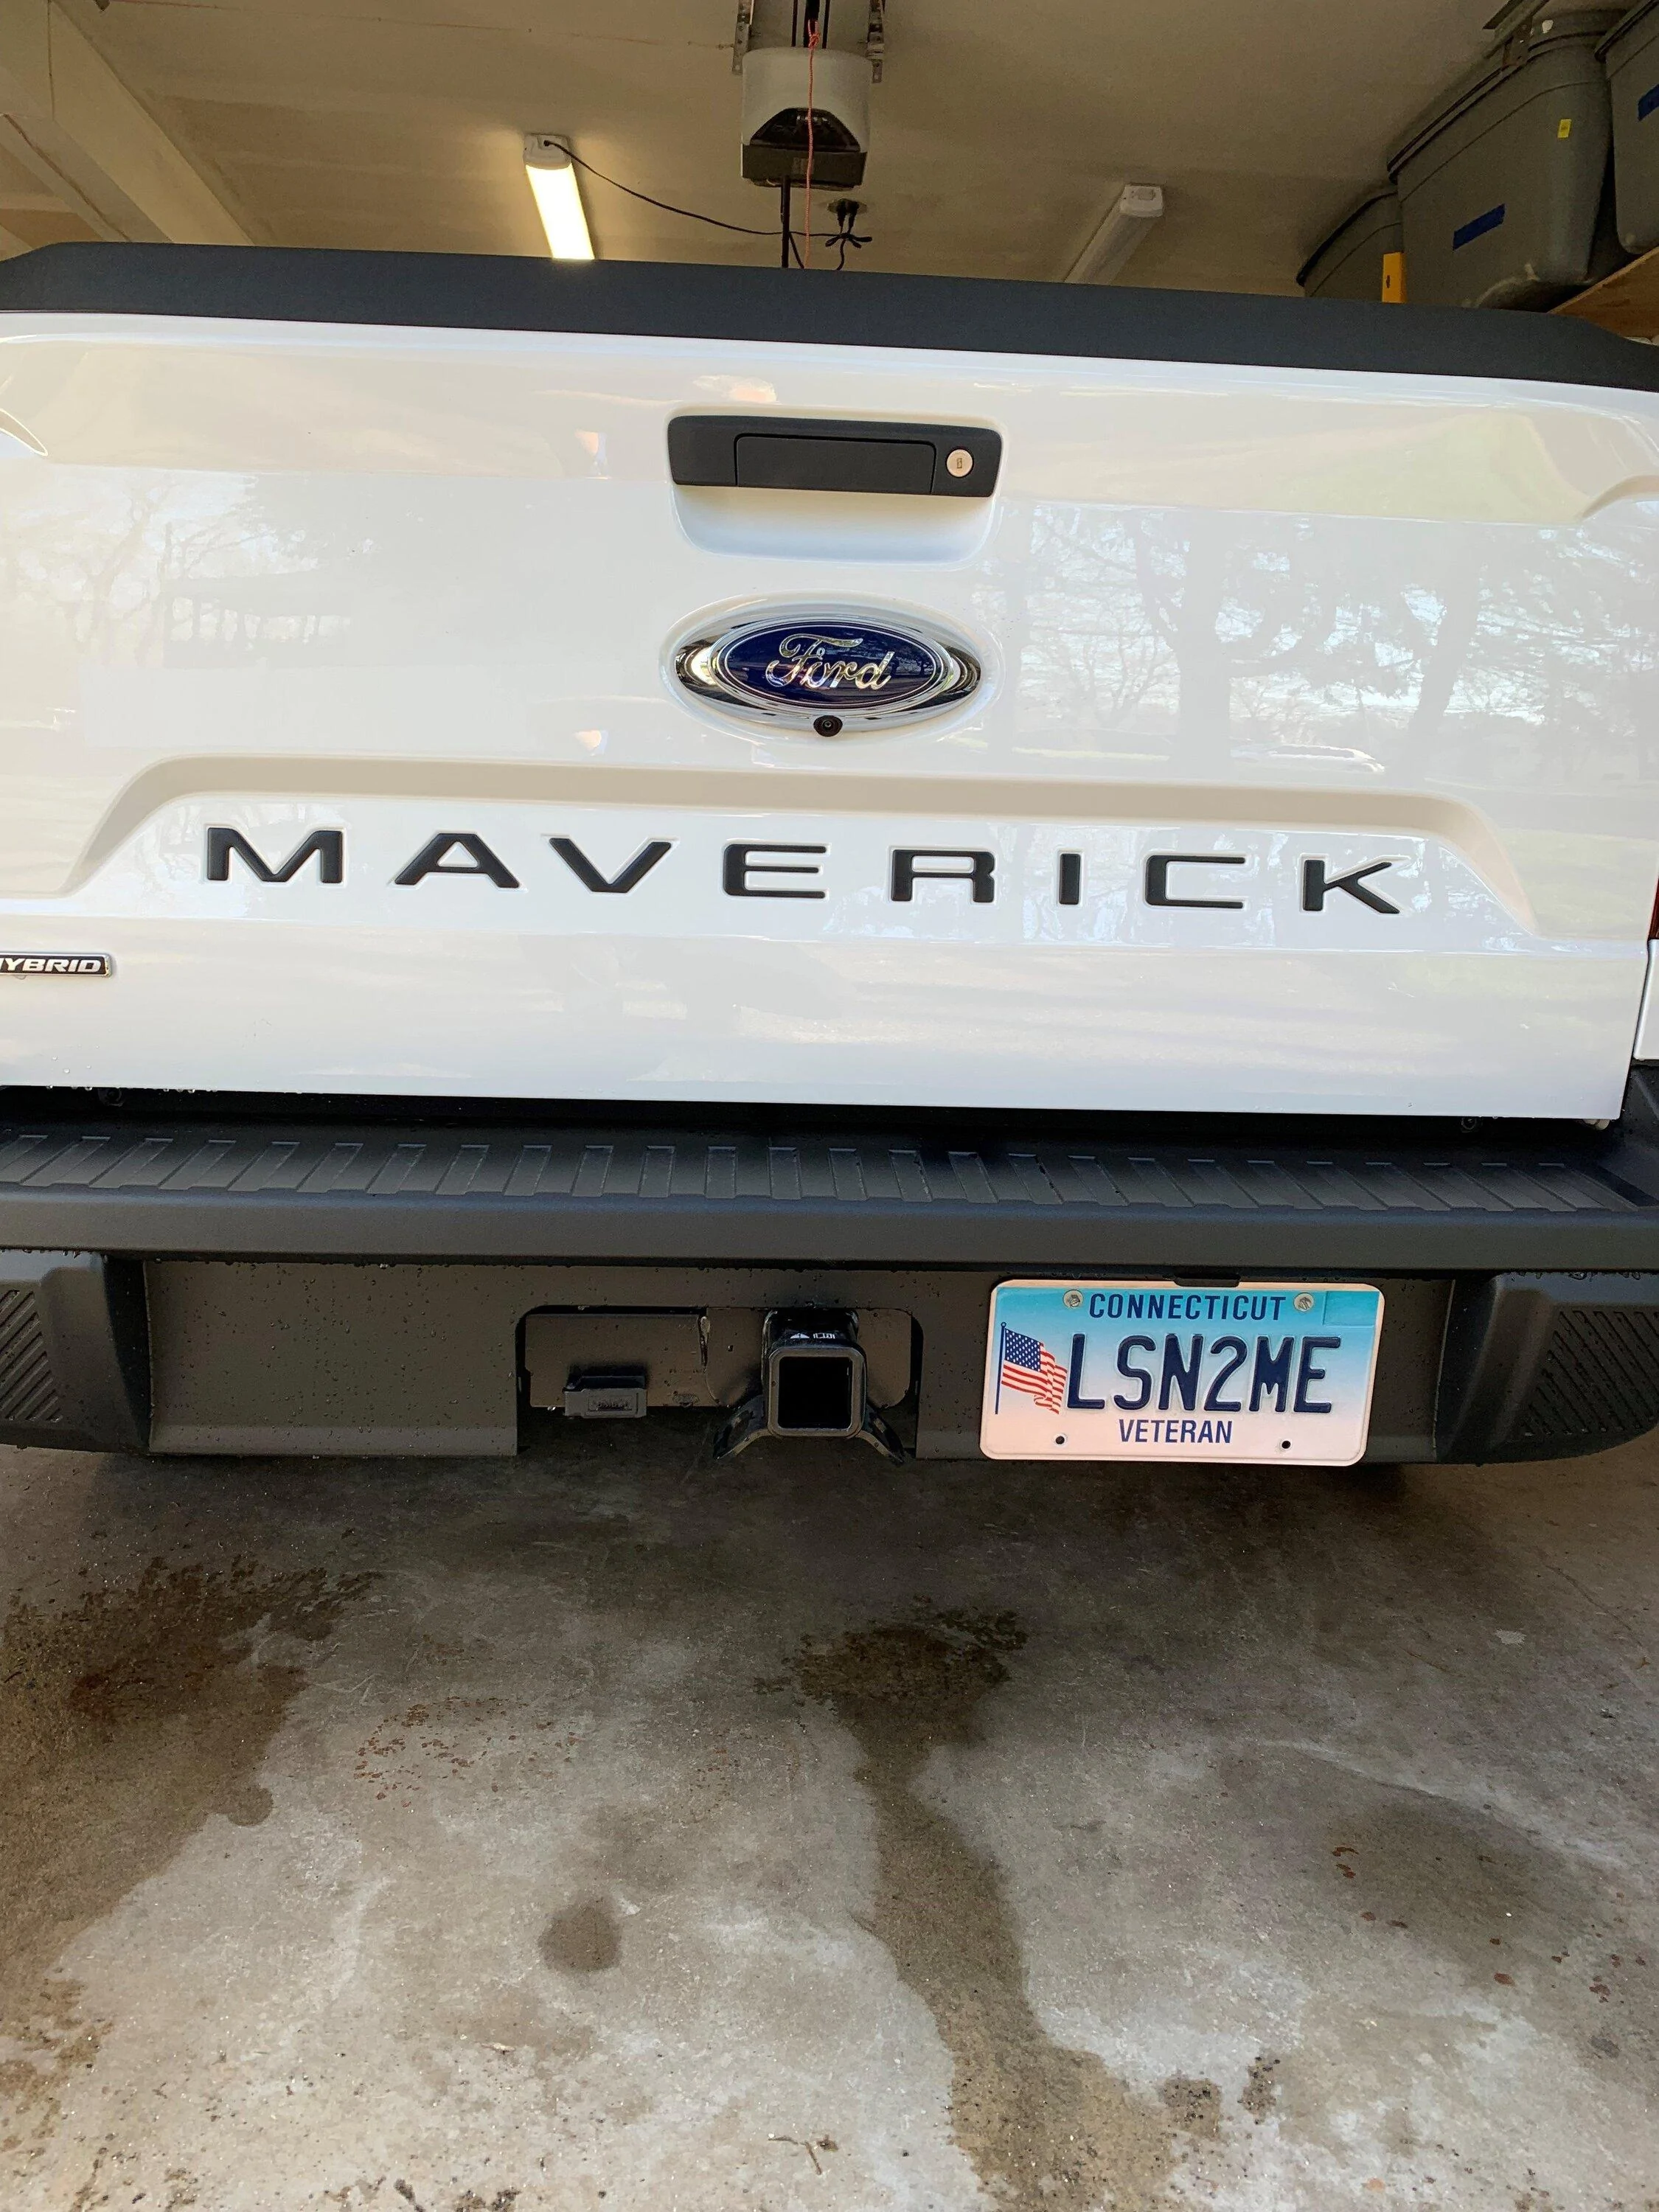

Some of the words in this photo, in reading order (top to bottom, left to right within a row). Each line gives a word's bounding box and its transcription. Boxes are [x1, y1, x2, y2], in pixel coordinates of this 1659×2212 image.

[765, 633, 894, 690] Ford
[207, 827, 1400, 914] MAVERICK
[0, 958, 102, 973] YBRID
[1088, 1293, 1287, 1321] CONNECTICUT
[1066, 1333, 1342, 1413] LSN2ME
[1119, 1419, 1234, 1444] VETERAN
